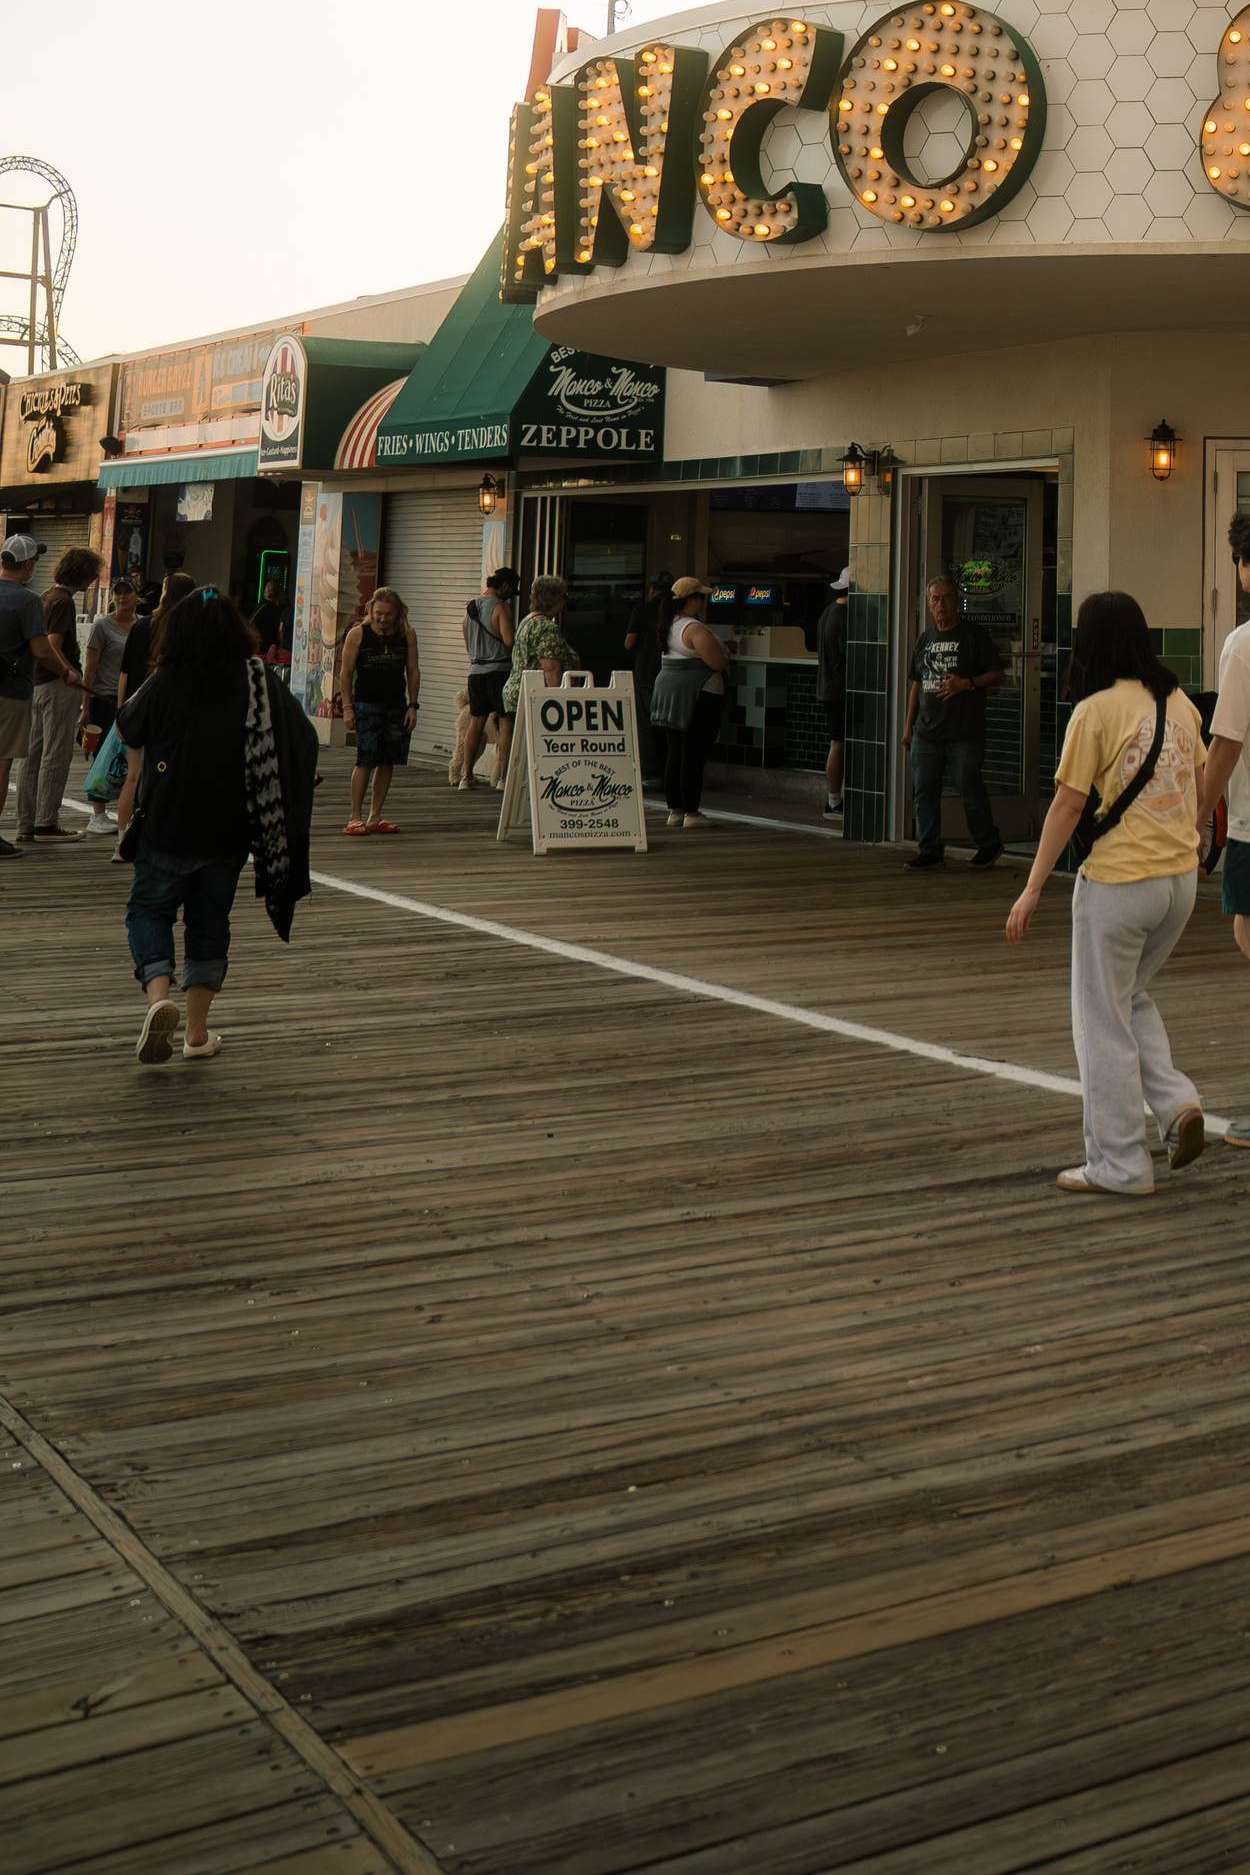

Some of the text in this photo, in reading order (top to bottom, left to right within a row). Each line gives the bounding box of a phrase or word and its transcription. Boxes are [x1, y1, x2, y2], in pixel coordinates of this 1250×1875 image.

[604, 378, 614, 389] &
[583, 398, 611, 408] PIZZA
[377, 423, 508, 456] FRIES WINGS TENDERS
[520, 424, 655, 451] ZEPPOLE
[718, 588, 736, 601] pepsi
[754, 588, 772, 601] pepsi
[541, 699, 625, 732] OPEN
[543, 737, 626, 753] Year Round
[554, 759, 617, 777] BEST OF THE BEST
[586, 782, 595, 791] &
[570, 798, 595, 807] PIZZA
[560, 818, 619, 830] 399-2548
[549, 828, 631, 840] mancospizza.com
